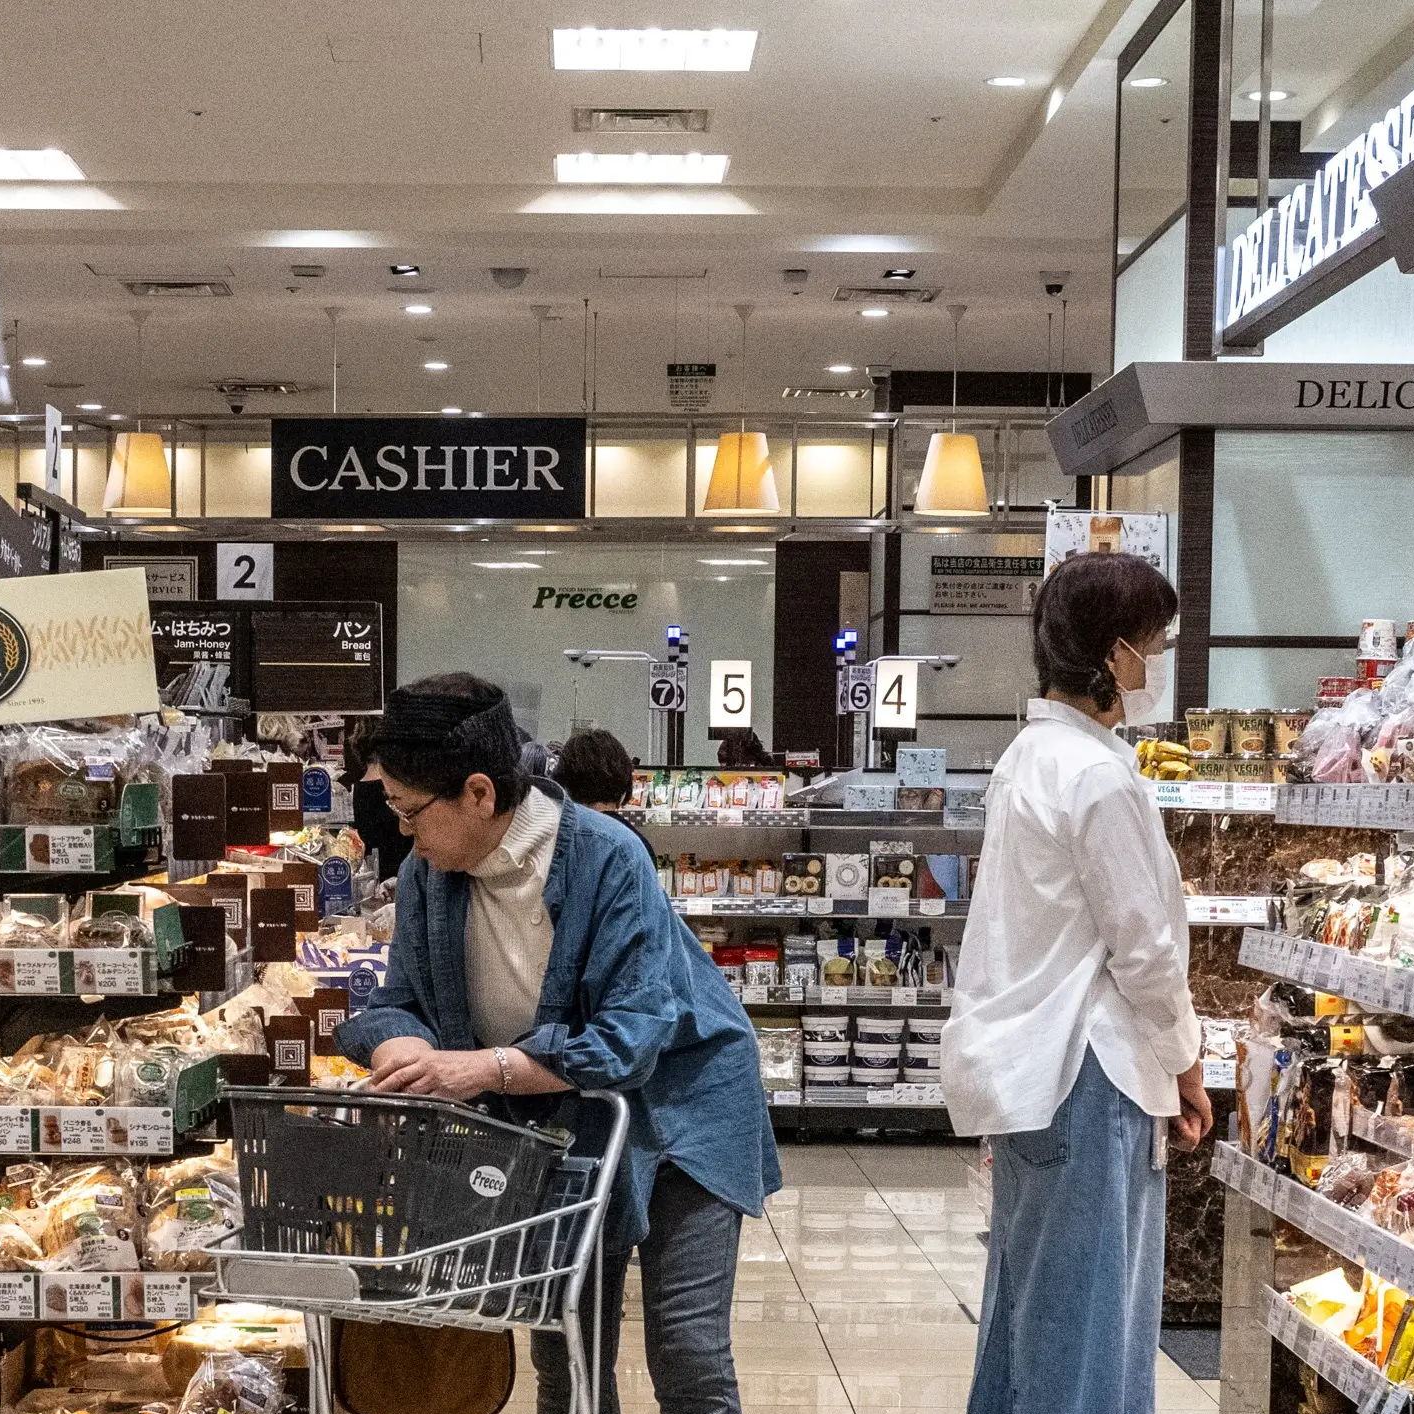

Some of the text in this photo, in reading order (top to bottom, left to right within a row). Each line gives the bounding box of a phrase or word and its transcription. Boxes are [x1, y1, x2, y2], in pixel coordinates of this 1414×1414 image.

[52, 426, 58, 479] 2
[290, 445, 563, 491] CASHIER
[233, 555, 256, 589] 2
[532, 587, 638, 609] Precce
[333, 622, 371, 638] パン
[341, 641, 371, 650] Bread
[655, 684, 672, 705] 7
[723, 674, 745, 714] 5
[853, 686, 868, 706] 5
[882, 674, 907, 715] 4
[1286, 719, 1309, 727] VEGA
[473, 1170, 505, 1193] Precce
